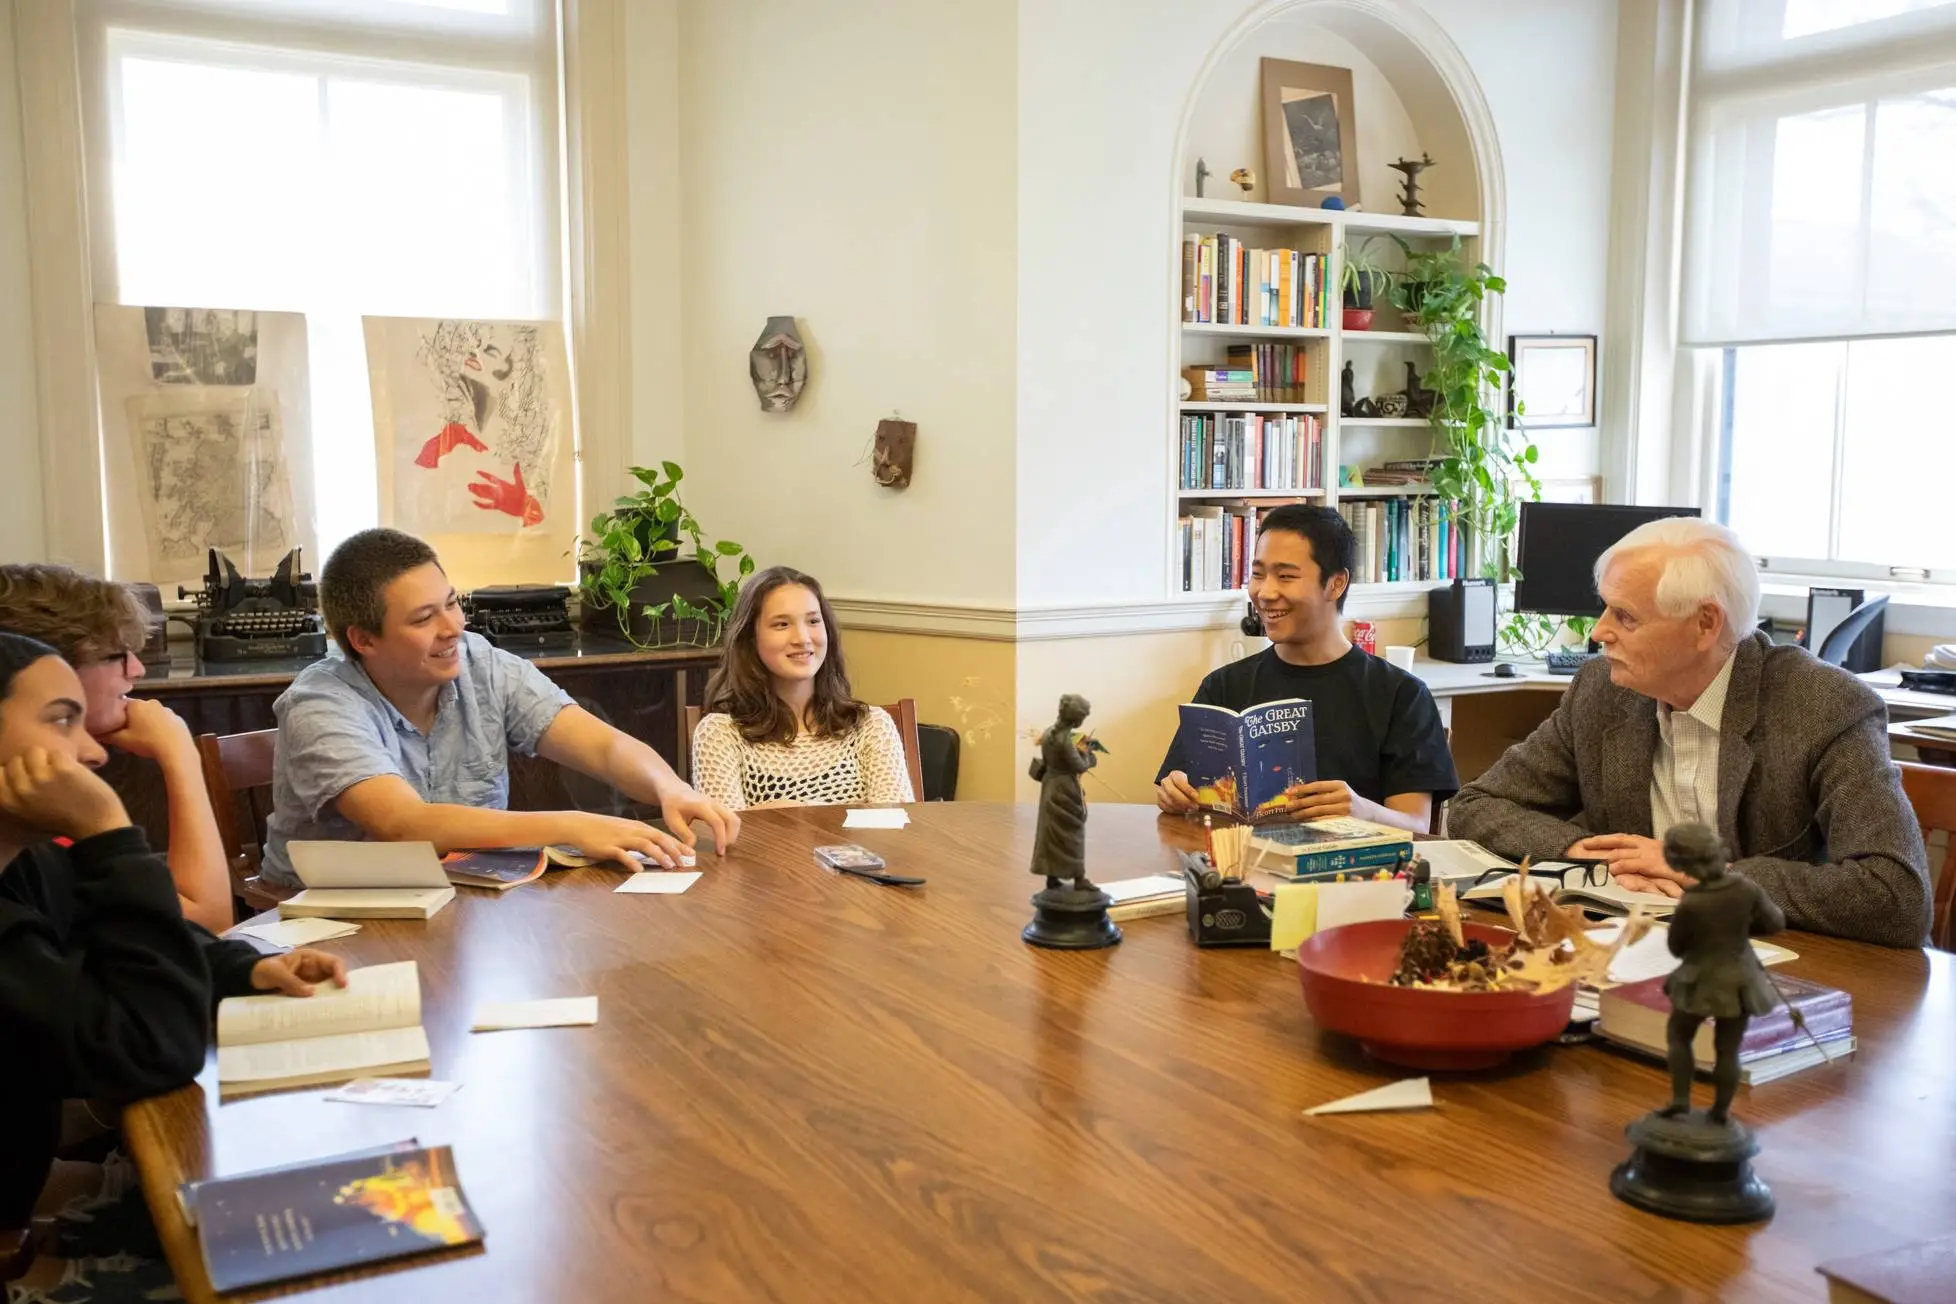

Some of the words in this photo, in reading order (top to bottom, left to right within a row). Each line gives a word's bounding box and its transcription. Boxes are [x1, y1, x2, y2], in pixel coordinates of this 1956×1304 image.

[1245, 715, 1263, 728] The
[1265, 707, 1307, 721] GREAT
[1249, 720, 1300, 738] GATSBY
